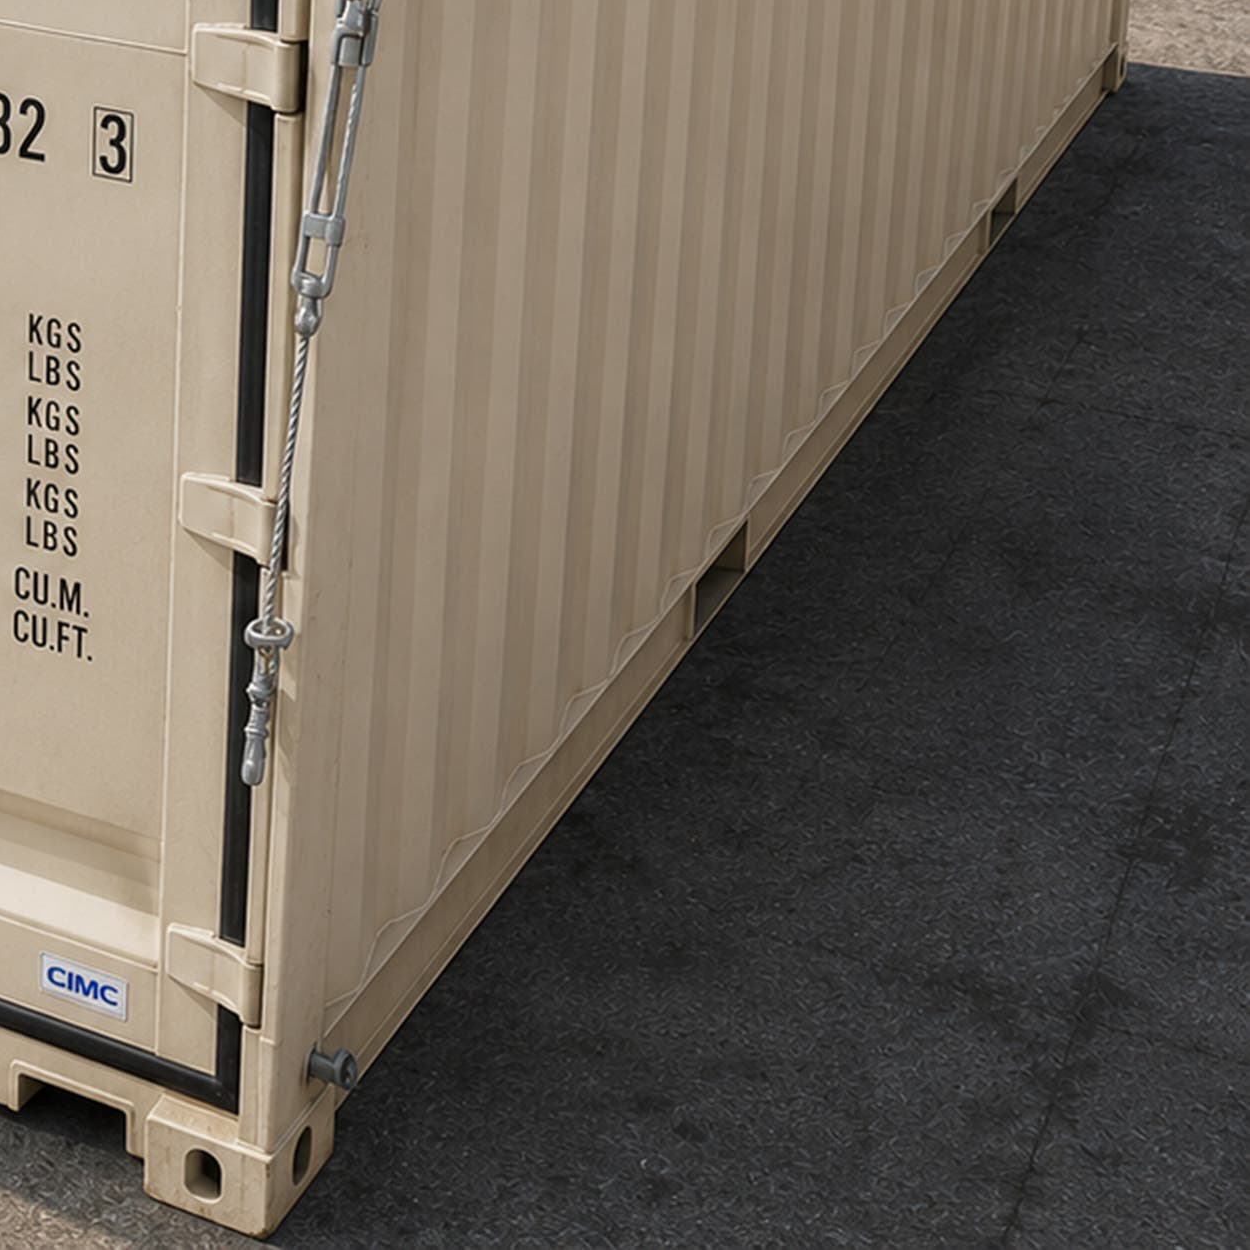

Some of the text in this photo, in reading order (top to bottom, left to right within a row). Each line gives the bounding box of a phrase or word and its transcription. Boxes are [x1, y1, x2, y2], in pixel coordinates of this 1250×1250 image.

[97, 112, 129, 177] 3
[28, 313, 82, 354] KGS
[28, 350, 81, 392] LBS
[27, 395, 80, 436] KGS
[27, 433, 79, 475] LBS
[26, 477, 79, 519] KGS
[26, 515, 78, 557] LBS
[14, 566, 90, 618] CU.M.
[13, 609, 93, 662] CU.FT.
[47, 966, 119, 1007] CIMC
